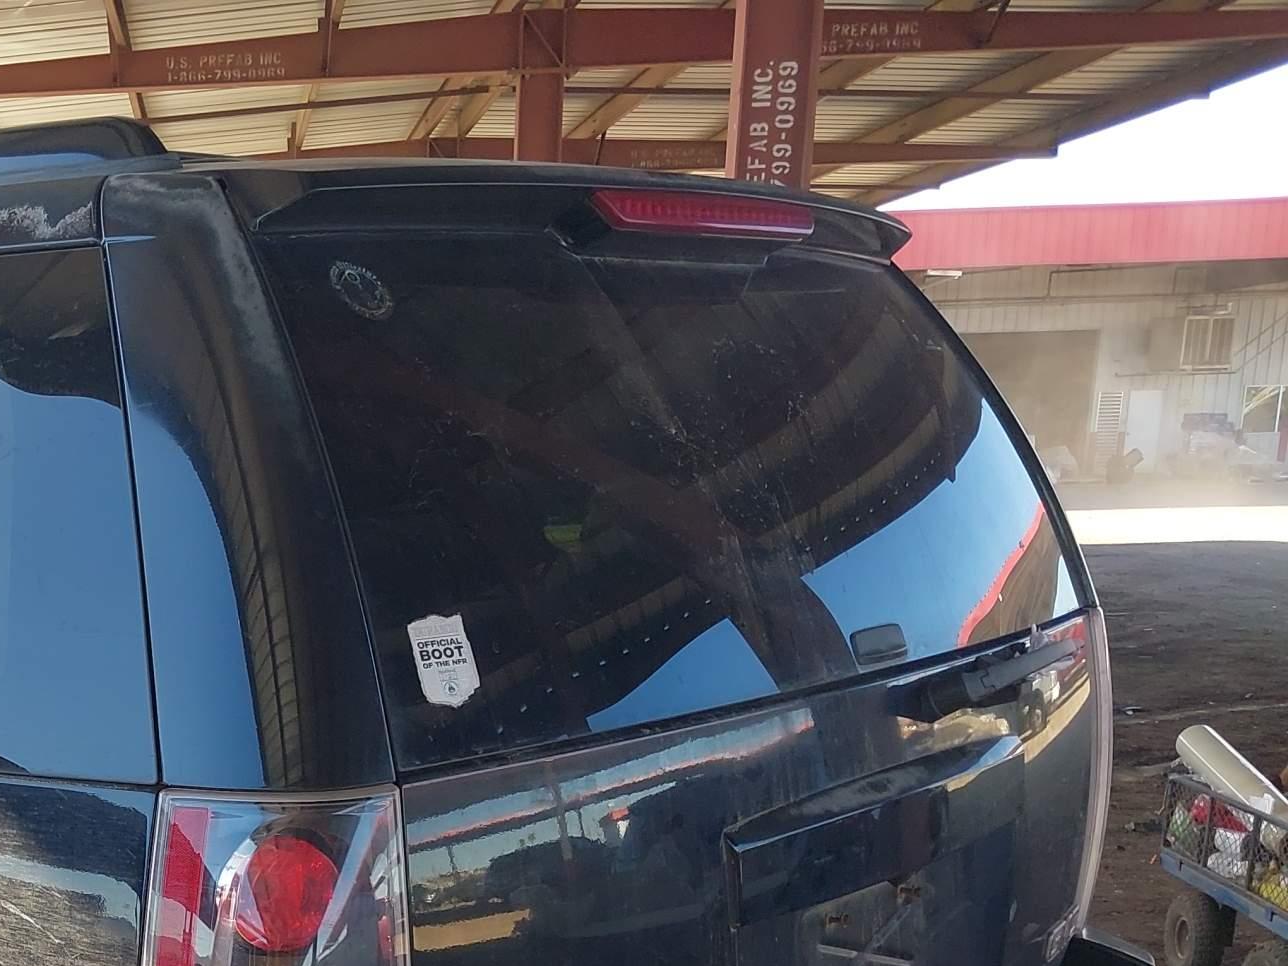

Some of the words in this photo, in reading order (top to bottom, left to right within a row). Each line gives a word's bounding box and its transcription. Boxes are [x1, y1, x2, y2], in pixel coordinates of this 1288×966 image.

[832, 22, 888, 38] PREFAB
[199, 53, 253, 68] PREFAB
[751, 60, 775, 108] INC.
[417, 637, 463, 649] OFFICIAL
[419, 645, 464, 662] BOOT
[422, 662, 434, 670] OF
[436, 659, 451, 668] THE
[452, 657, 468, 666] NFR
